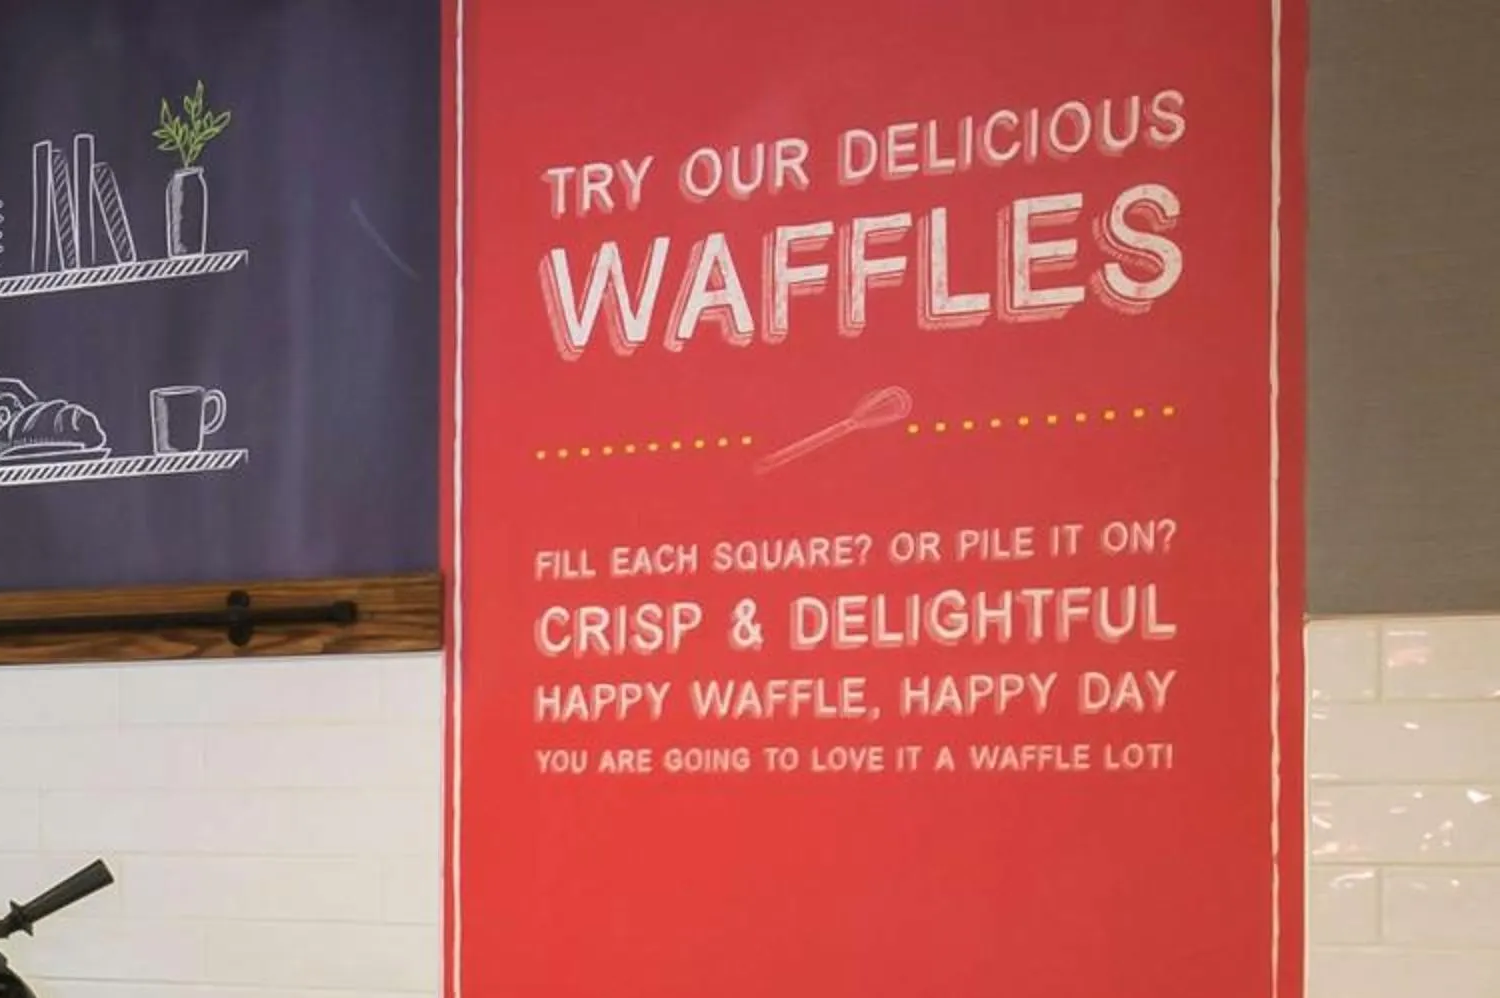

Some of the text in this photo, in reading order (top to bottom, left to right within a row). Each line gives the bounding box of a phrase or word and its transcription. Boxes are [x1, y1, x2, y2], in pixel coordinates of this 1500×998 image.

[542, 89, 1186, 217] TRY OUR DELICIOUS
[539, 183, 1184, 362] WAFFLES
[535, 519, 1177, 580] FILL EACH SQUARE? OR PILE IT ON?
[535, 584, 1177, 659] CRISP & DELIGHTFUL
[535, 669, 1177, 723] HAPPY WAFFLE, HAPPY DAY
[535, 749, 587, 774] YOU
[599, 748, 653, 773] ARE
[663, 748, 750, 773] GOING
[765, 747, 798, 771] TO
[811, 745, 884, 771] LOVE
[896, 745, 922, 771] IT
[934, 746, 955, 772] A
[970, 744, 1091, 771] WAFFLE
